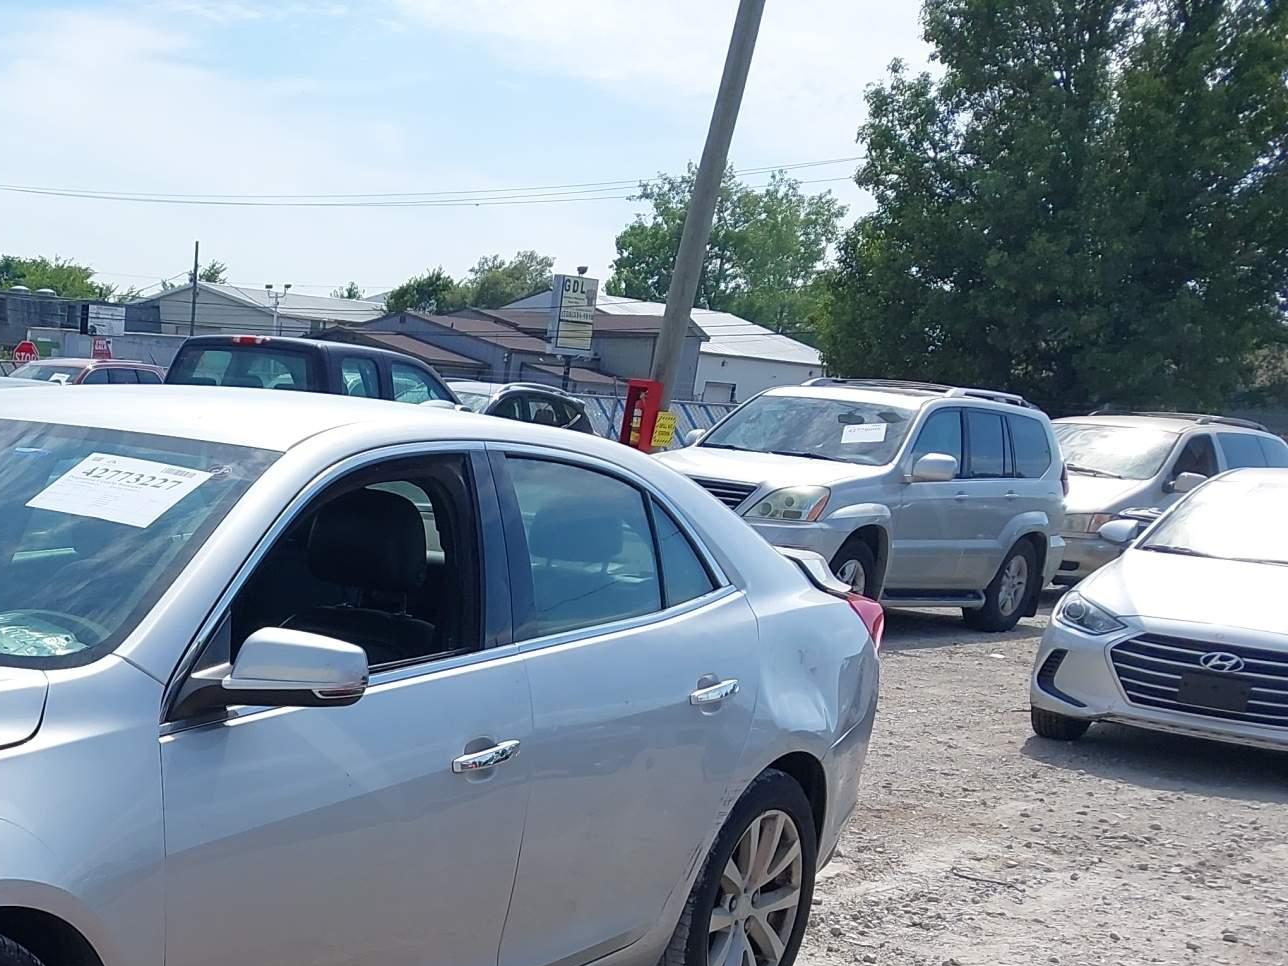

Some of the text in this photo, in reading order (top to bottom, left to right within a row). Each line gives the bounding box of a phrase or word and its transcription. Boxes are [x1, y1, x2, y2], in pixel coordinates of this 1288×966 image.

[564, 279, 586, 294] GDL
[15, 351, 37, 362] STOP
[82, 466, 184, 490] 42773227
